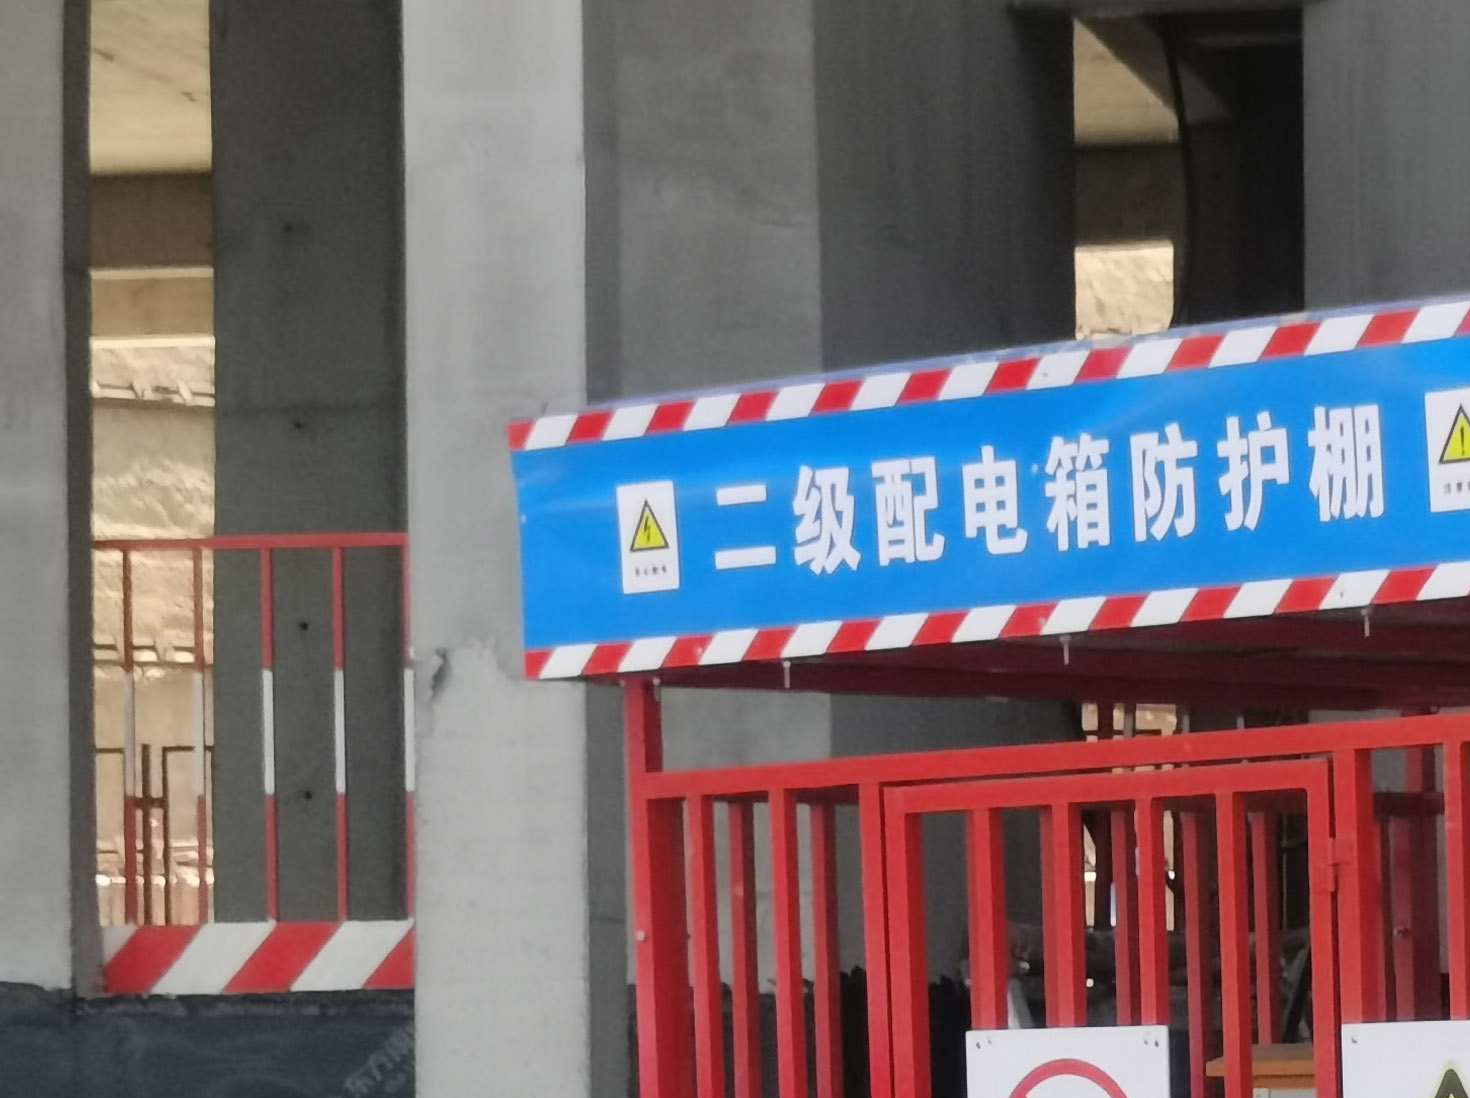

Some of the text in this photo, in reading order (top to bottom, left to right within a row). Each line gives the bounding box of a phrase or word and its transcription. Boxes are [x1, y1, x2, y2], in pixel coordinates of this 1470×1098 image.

[714, 404, 1386, 575] 二级配电箱防护棚
